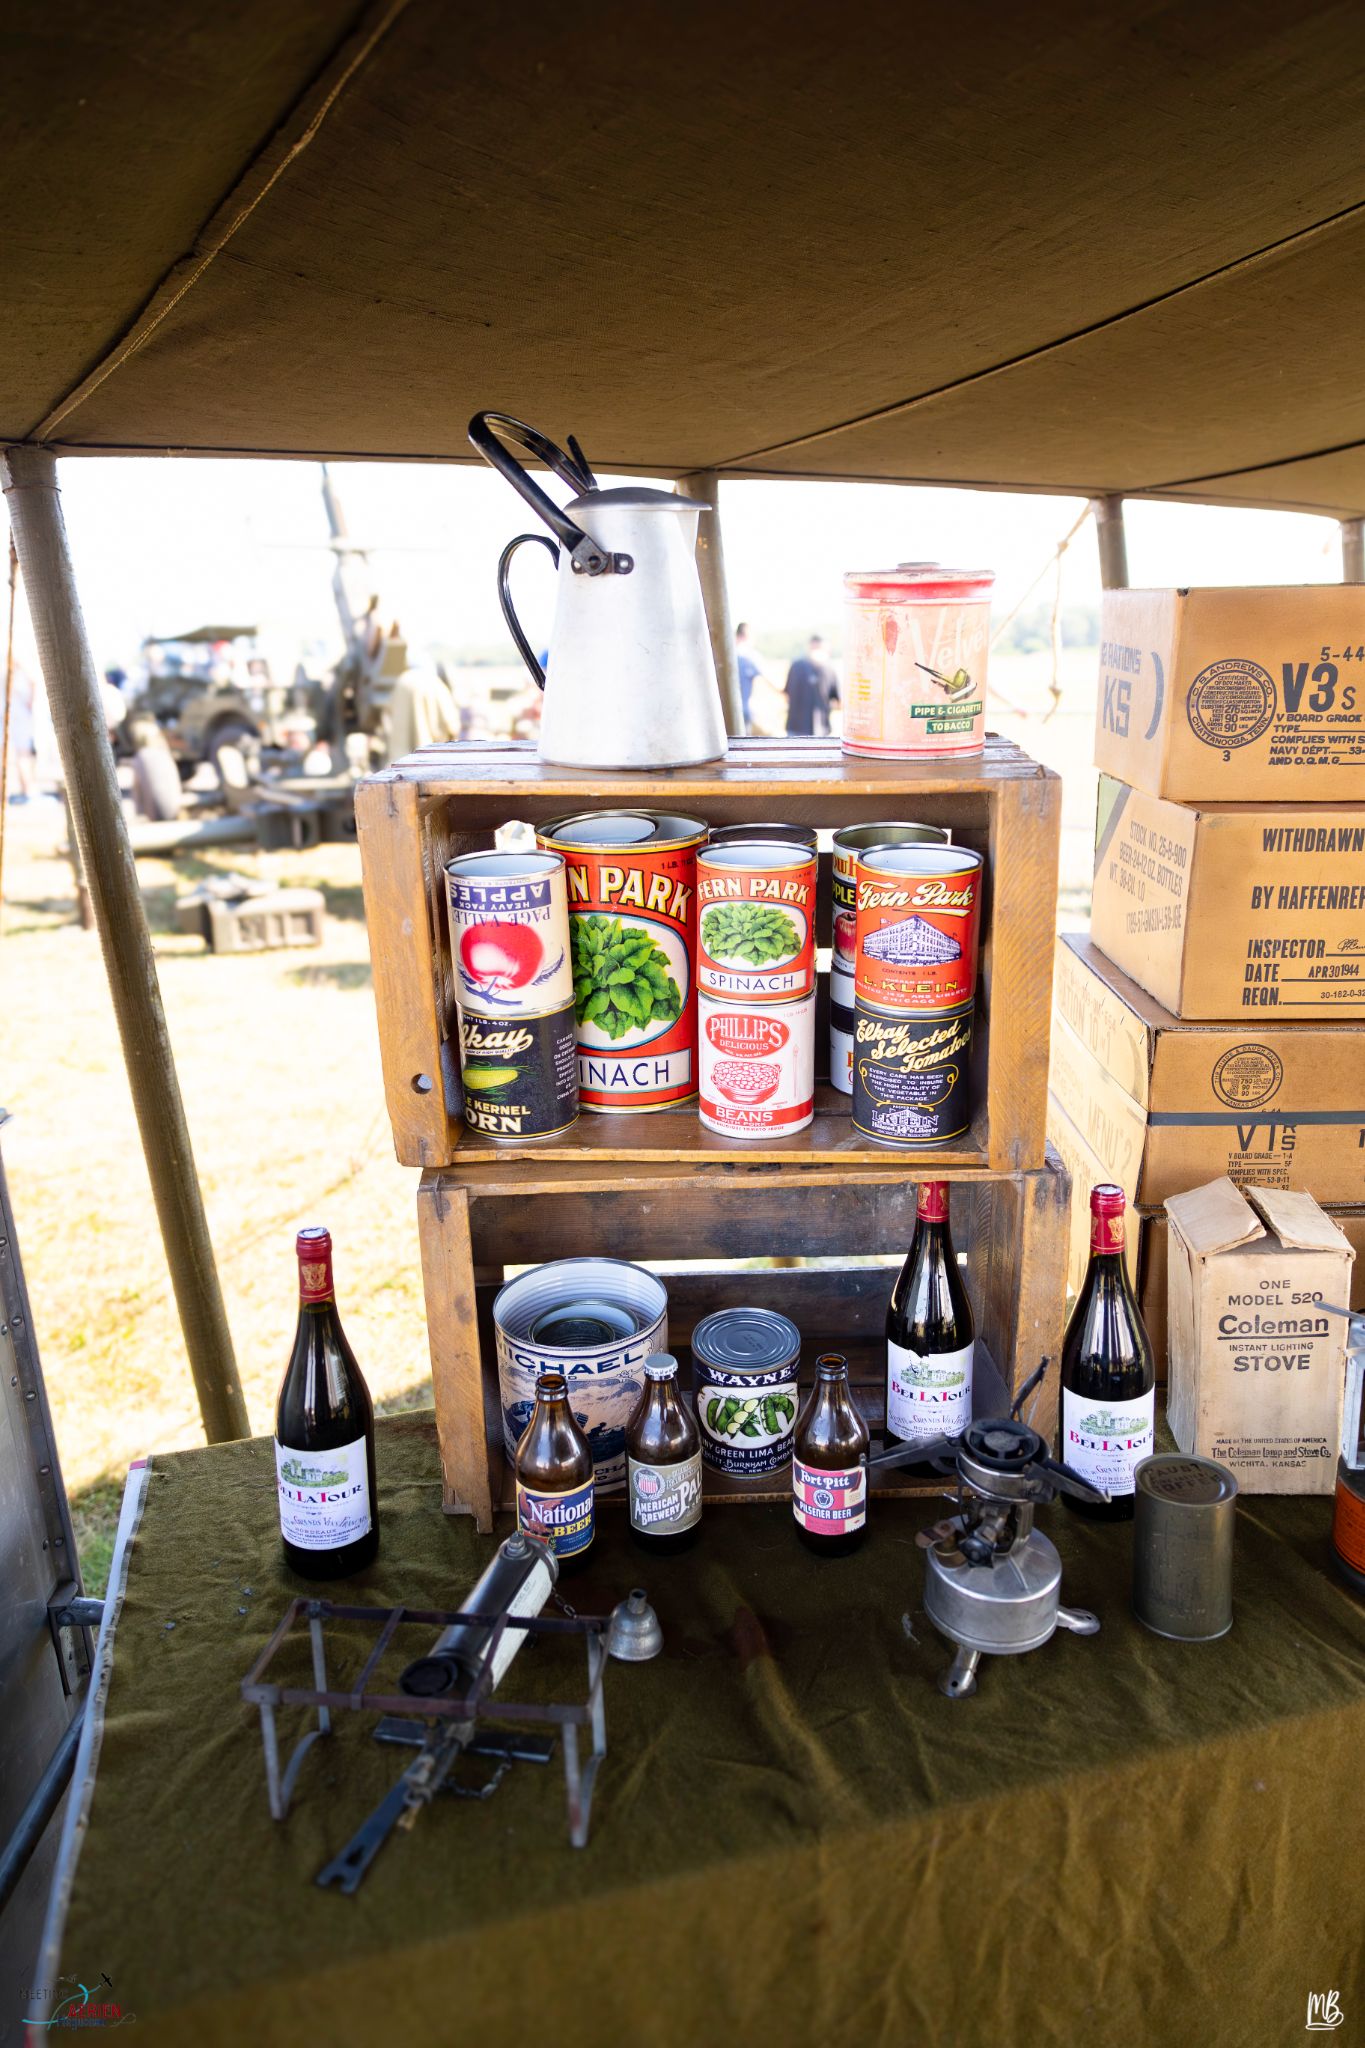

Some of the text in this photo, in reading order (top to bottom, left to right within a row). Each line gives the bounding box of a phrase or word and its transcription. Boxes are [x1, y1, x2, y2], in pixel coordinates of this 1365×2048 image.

[1210, 662, 1264, 679] ANDREWS
[914, 707, 936, 716] PIPE
[1287, 714, 1323, 722] BOARD
[931, 720, 971, 731] TOBACCO
[1274, 725, 1300, 733] TYPE
[1271, 735, 1356, 744] COMPLIES WITH
[1222, 750, 1231, 762] 3
[1270, 746, 1299, 755] NAVY
[1262, 828, 1365, 852] WITHDRAWN
[449, 882, 545, 903] APPLES
[597, 864, 694, 928] PARK
[697, 878, 810, 907] FERN PARK
[857, 880, 974, 912] Fern Park
[1251, 886, 1274, 910] BY
[458, 901, 530, 911] HEAVY PACK
[507, 907, 551, 926] PAGE
[1247, 939, 1326, 958] INSPECTOR
[1244, 963, 1280, 982] DATE
[709, 973, 793, 991] SPINACH
[881, 981, 958, 993] KLEIN
[710, 1017, 783, 1048] PHILLIPS
[856, 1018, 911, 1044] Elkay
[871, 1020, 962, 1060] Selected
[719, 1039, 769, 1051] DELICIOUS
[474, 1100, 531, 1116] KERNEL
[715, 1107, 773, 1122] BEANS
[1227, 1168, 1256, 1176] COMPLIES
[1259, 1279, 1291, 1290] ONE
[1228, 1291, 1323, 1306] MODEL 520
[1218, 1314, 1329, 1335] Coleman
[1229, 1342, 1314, 1352] INSTANT LIGHTING
[1233, 1354, 1311, 1372] STOVE
[707, 1365, 791, 1387] WAYNE
[715, 1446, 745, 1459] GREEN
[749, 1447, 774, 1459] LIMA
[1211, 1447, 1227, 1458] The
[1228, 1447, 1261, 1458] Coleman
[1262, 1447, 1281, 1459] Lamp
[1283, 1447, 1298, 1458] and
[1298, 1447, 1319, 1458] Stove
[1272, 1460, 1307, 1468] KANSAS
[801, 1469, 850, 1490] Fort Pitt
[526, 1489, 594, 1525] National
[634, 1493, 679, 1521] AMERICAN
[641, 1503, 680, 1526] BREWERY
[799, 1501, 852, 1520] PILSENER BEER
[553, 1513, 592, 1537] BEER
